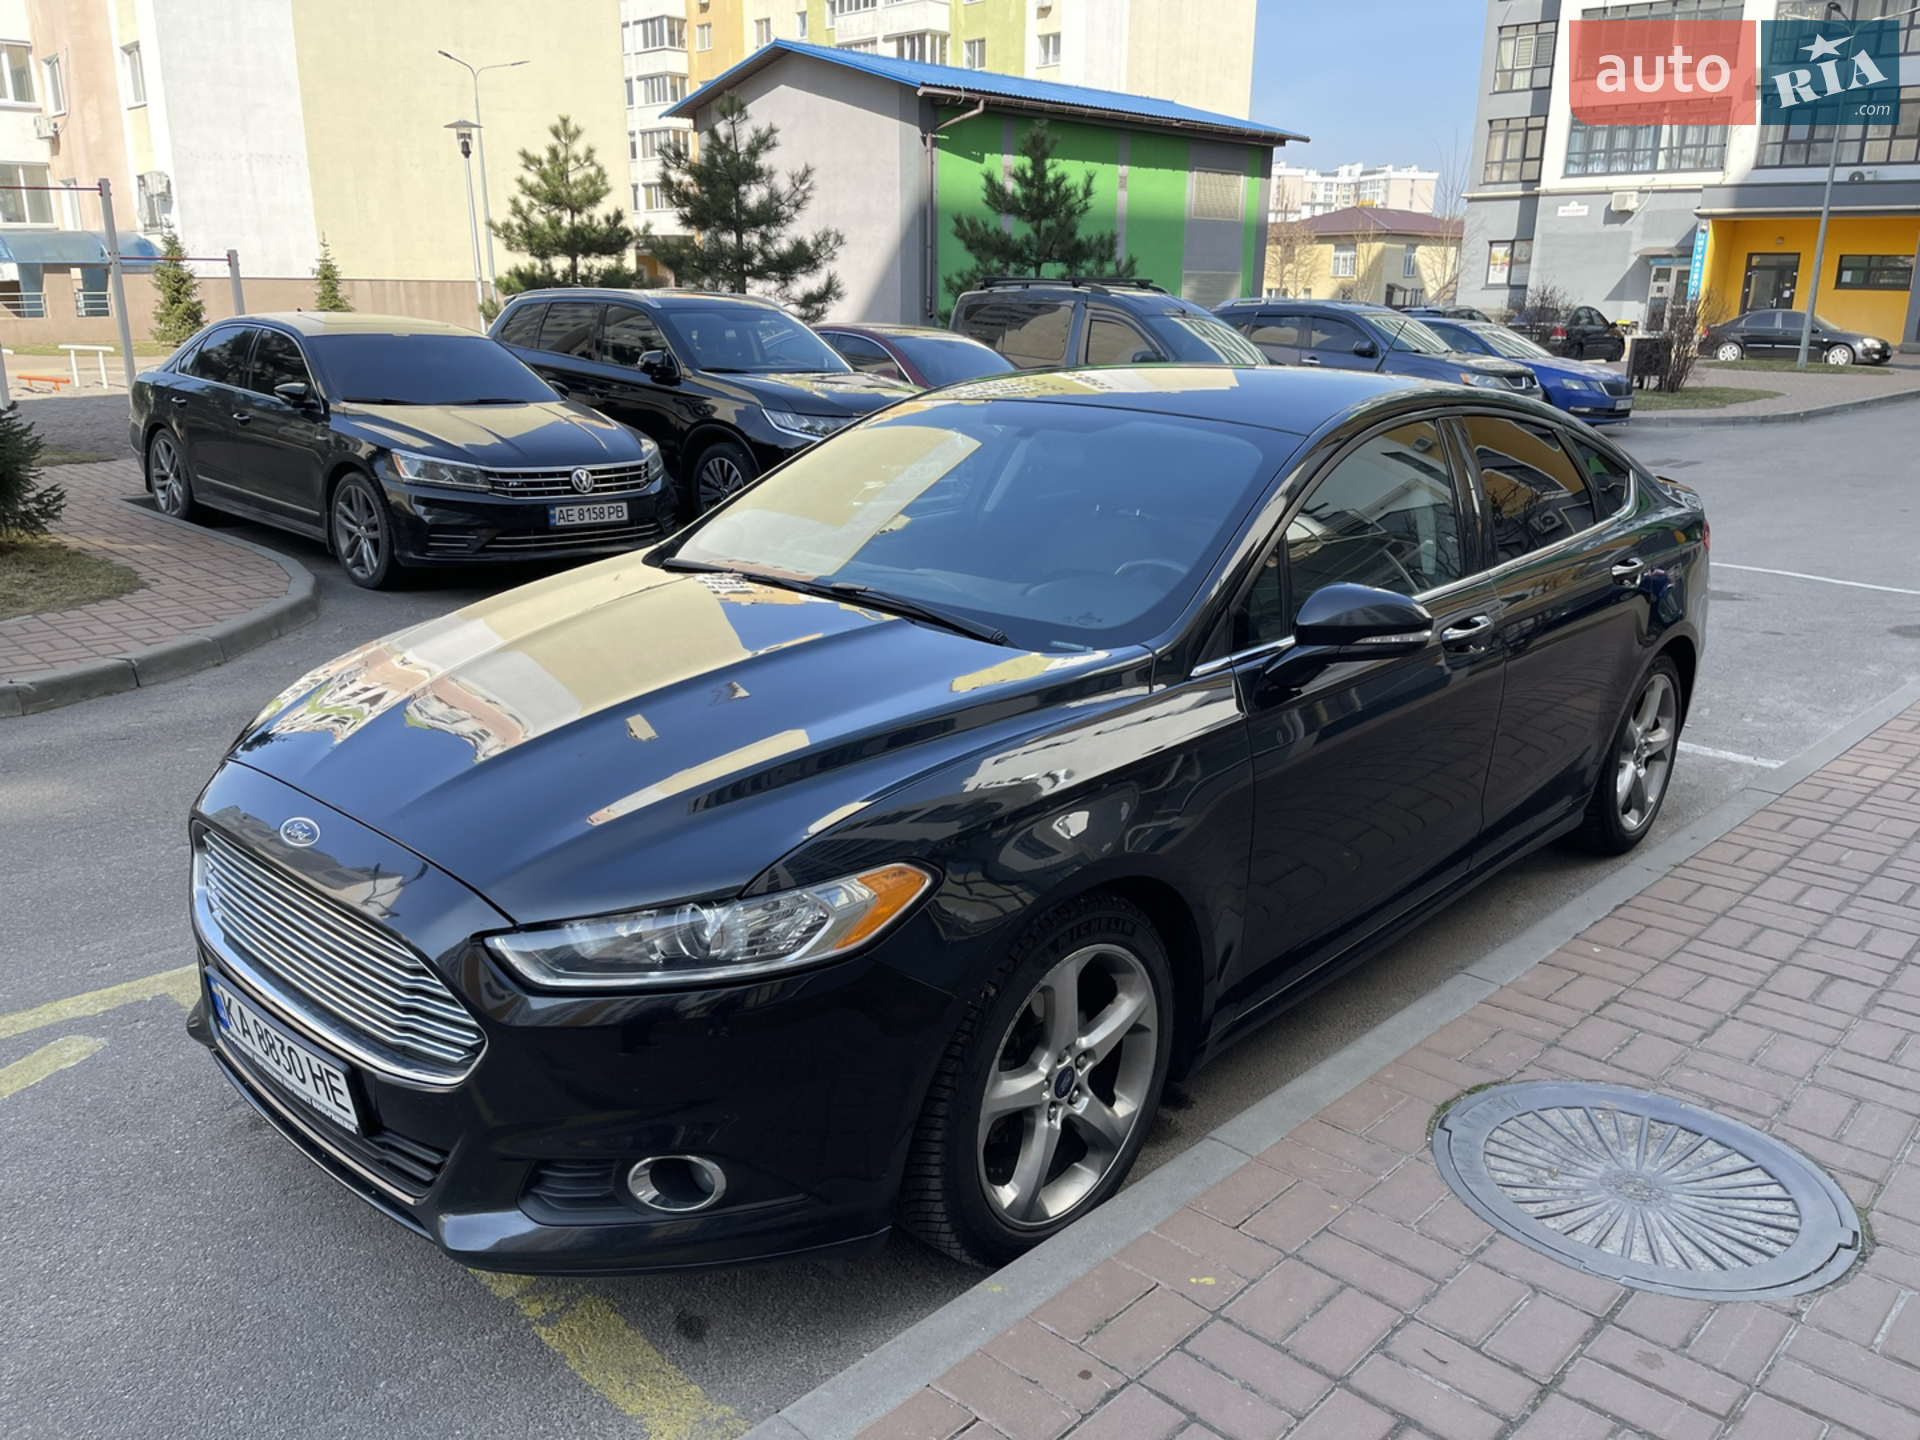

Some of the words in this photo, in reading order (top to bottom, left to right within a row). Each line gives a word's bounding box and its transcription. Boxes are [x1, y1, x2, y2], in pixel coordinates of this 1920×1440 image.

[557, 508, 575, 523] AE
[578, 506, 605, 521] 8158
[607, 505, 625, 519] PB
[286, 822, 312, 840] Ford
[1057, 917, 1134, 950] MICHELIN
[220, 991, 256, 1046] KA
[253, 1019, 306, 1085] 8830
[305, 1056, 351, 1114] HE
